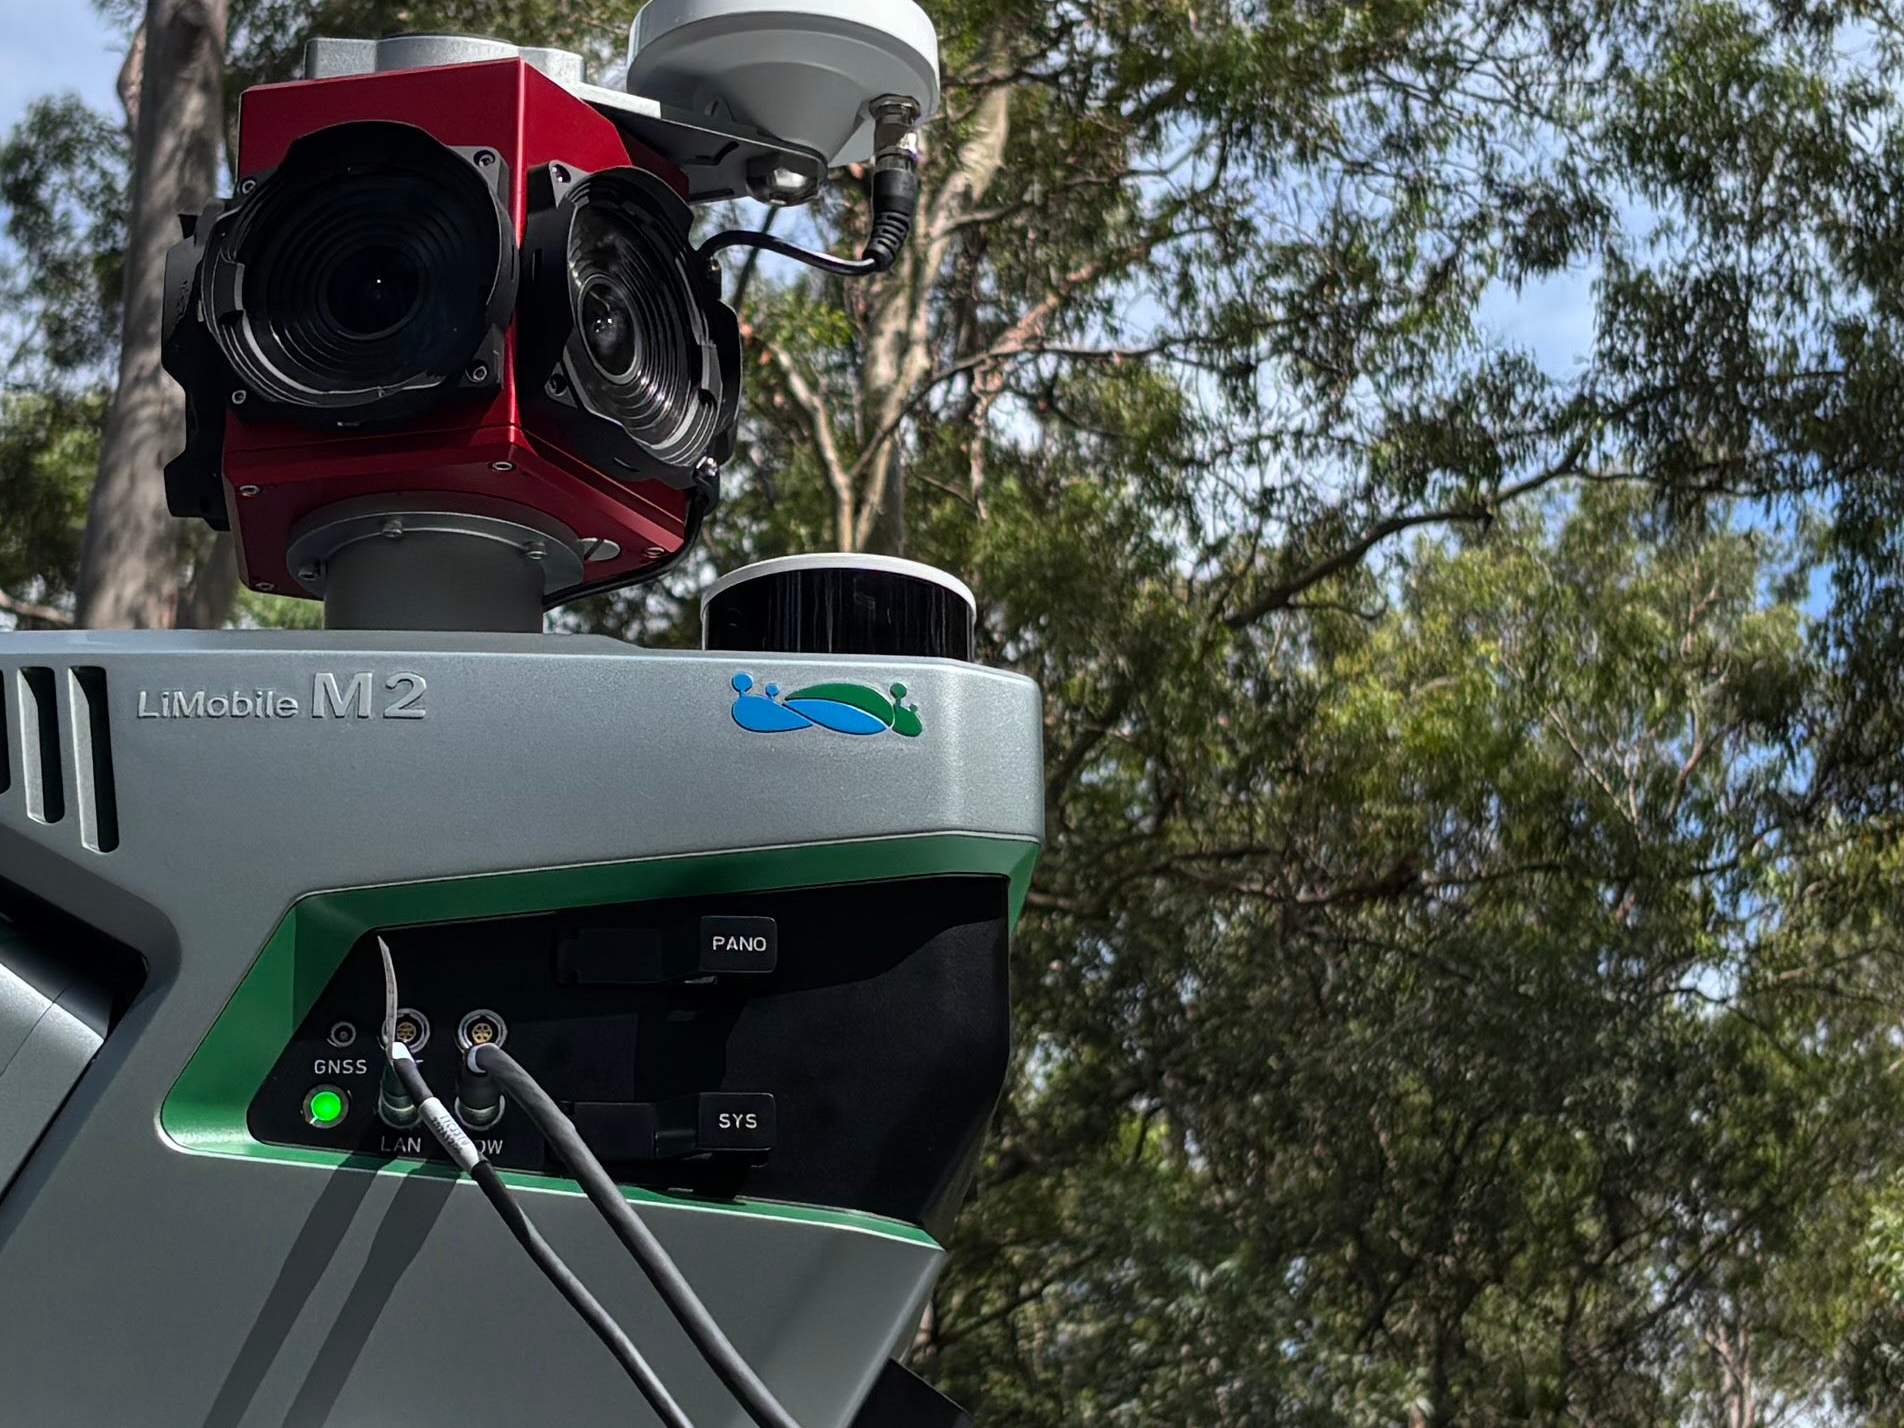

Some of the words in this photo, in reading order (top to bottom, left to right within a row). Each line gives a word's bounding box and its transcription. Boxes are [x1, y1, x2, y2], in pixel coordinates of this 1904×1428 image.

[136, 689, 299, 719] LiMobile
[311, 671, 428, 720] M2
[712, 935, 767, 952] PANO
[313, 1058, 367, 1074] GNSS
[718, 1113, 758, 1129] SYS
[380, 1135, 422, 1153] LAN
[474, 1139, 503, 1154] OW
